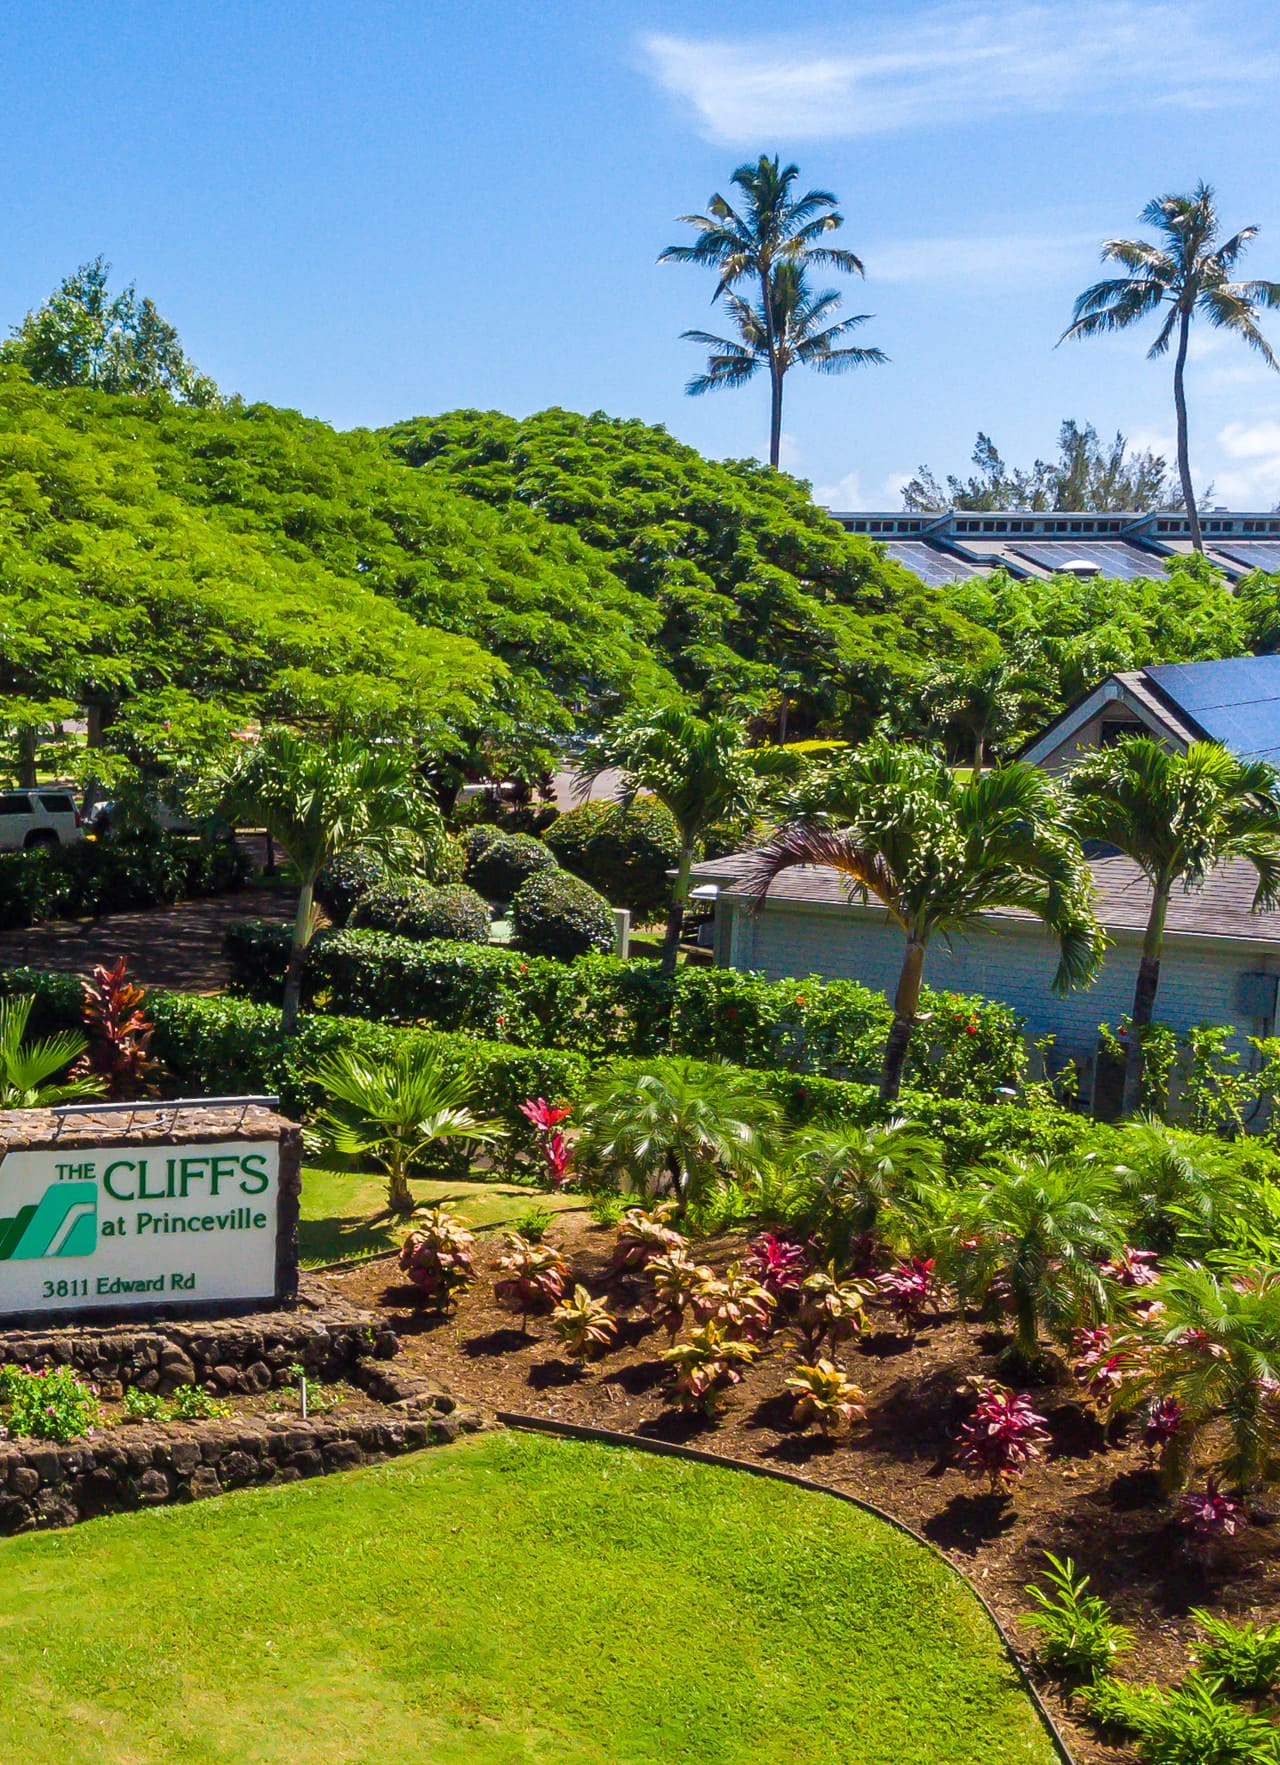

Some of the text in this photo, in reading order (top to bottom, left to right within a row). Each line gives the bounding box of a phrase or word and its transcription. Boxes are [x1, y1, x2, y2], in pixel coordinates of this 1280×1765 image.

[55, 1154, 269, 1201] THE CLIFFS
[101, 1208, 267, 1236] at Princeville
[42, 1272, 196, 1298] 3811 Edward Rd
